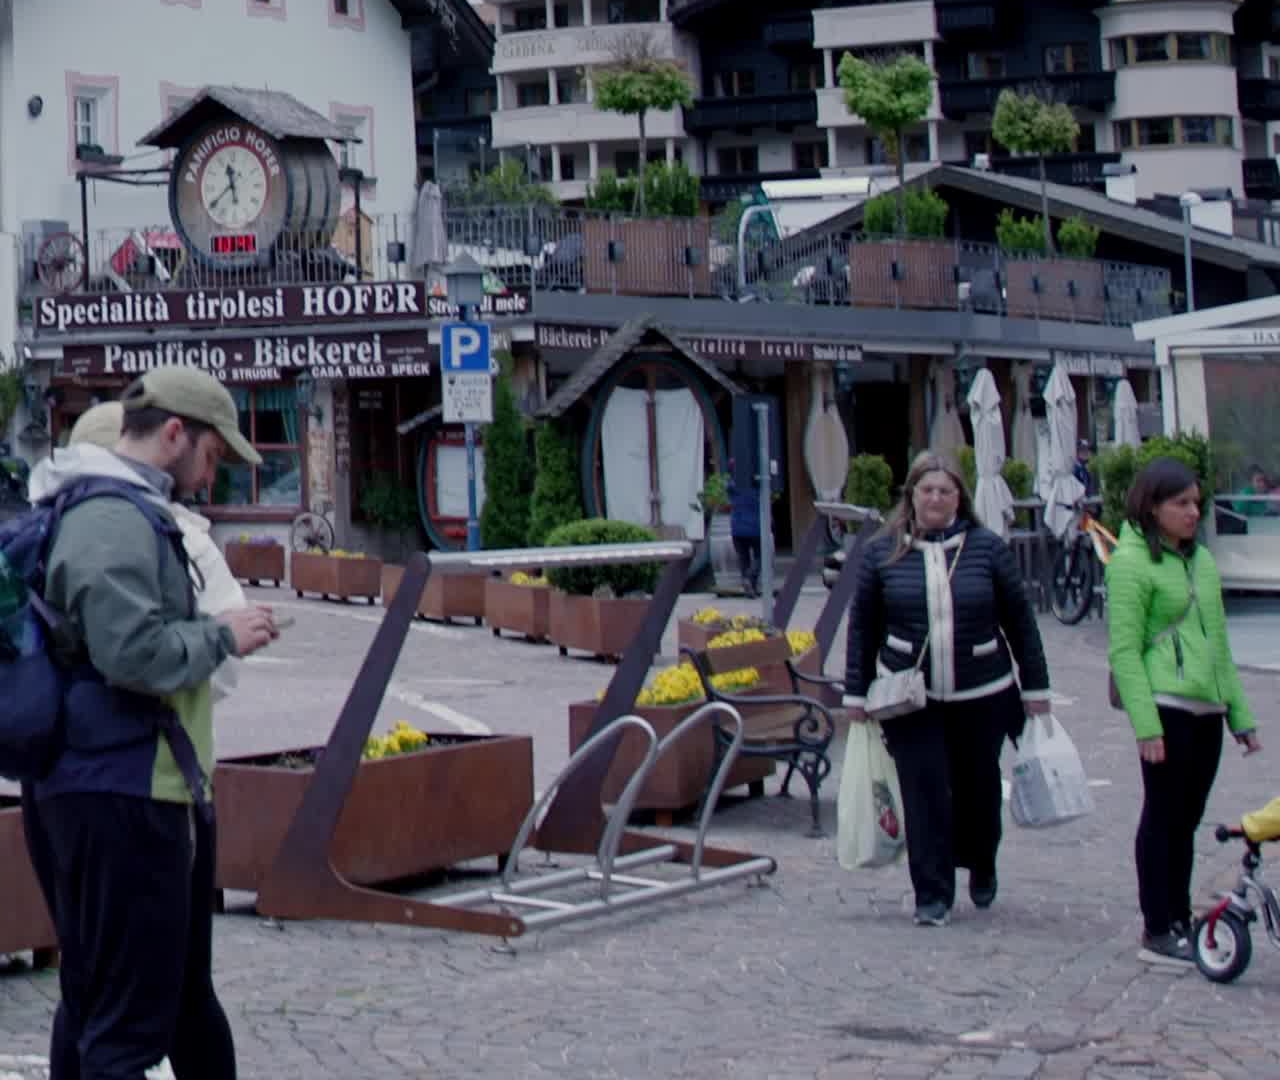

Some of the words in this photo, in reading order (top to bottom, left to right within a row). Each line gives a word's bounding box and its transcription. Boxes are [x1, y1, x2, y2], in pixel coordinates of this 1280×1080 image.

[40, 293, 170, 332] Specialità
[185, 288, 285, 321] tirolesi
[302, 283, 420, 316] HOFER
[103, 339, 227, 374] Panificio
[253, 333, 382, 368] Bäckerei
[450, 327, 481, 368] P
[232, 367, 281, 382] STRUDEL
[311, 365, 344, 380] CASA
[348, 364, 386, 378] DELLO
[391, 362, 431, 377] SPECK
